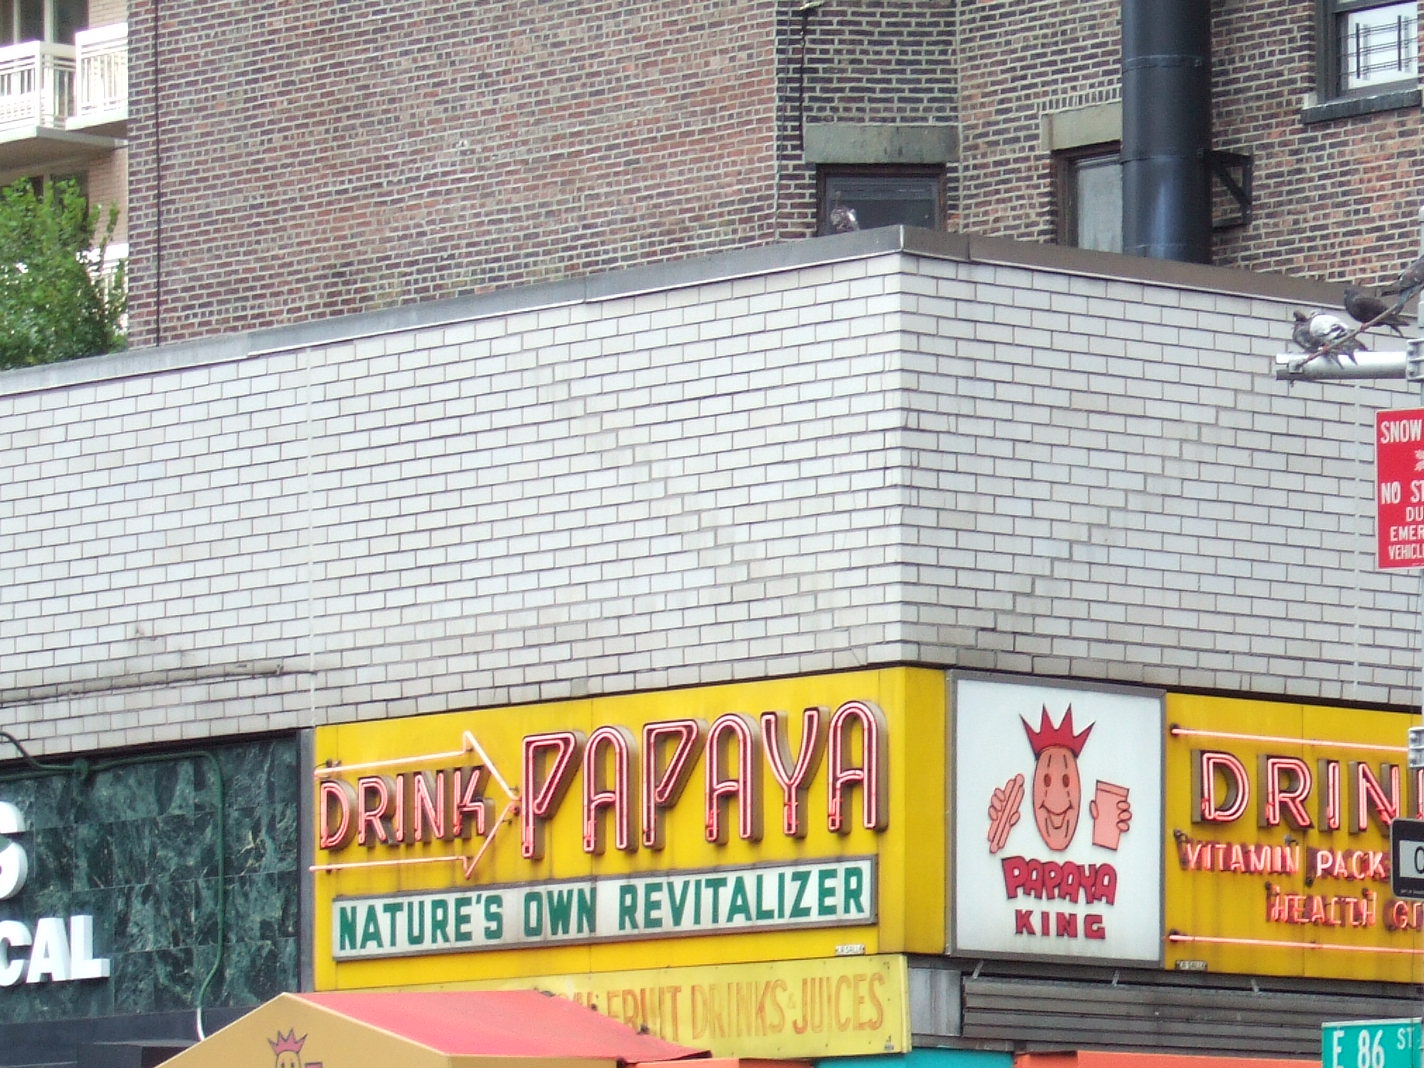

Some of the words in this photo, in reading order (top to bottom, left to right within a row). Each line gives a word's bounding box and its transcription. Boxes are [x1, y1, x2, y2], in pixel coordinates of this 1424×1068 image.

[1381, 419, 1422, 444] SNOW
[1381, 481, 1401, 504] NO
[319, 764, 490, 852] DRINK
[521, 701, 888, 860] PAPAYA
[1192, 748, 1424, 838] DRIN
[1184, 841, 1300, 875] VITAMIN
[1001, 855, 1117, 905] PAPAYA
[339, 892, 503, 951] NATURE'S
[523, 886, 597, 937] OWN
[618, 866, 865, 931] REVITALIZER
[1014, 908, 1107, 941] KING
[1267, 885, 1377, 928] HEALTH
[607, 984, 682, 1043] FRUIT
[691, 978, 787, 1041] DRINKS
[792, 972, 886, 1036] JUICES
[1397, 1027, 1414, 1050] ST
